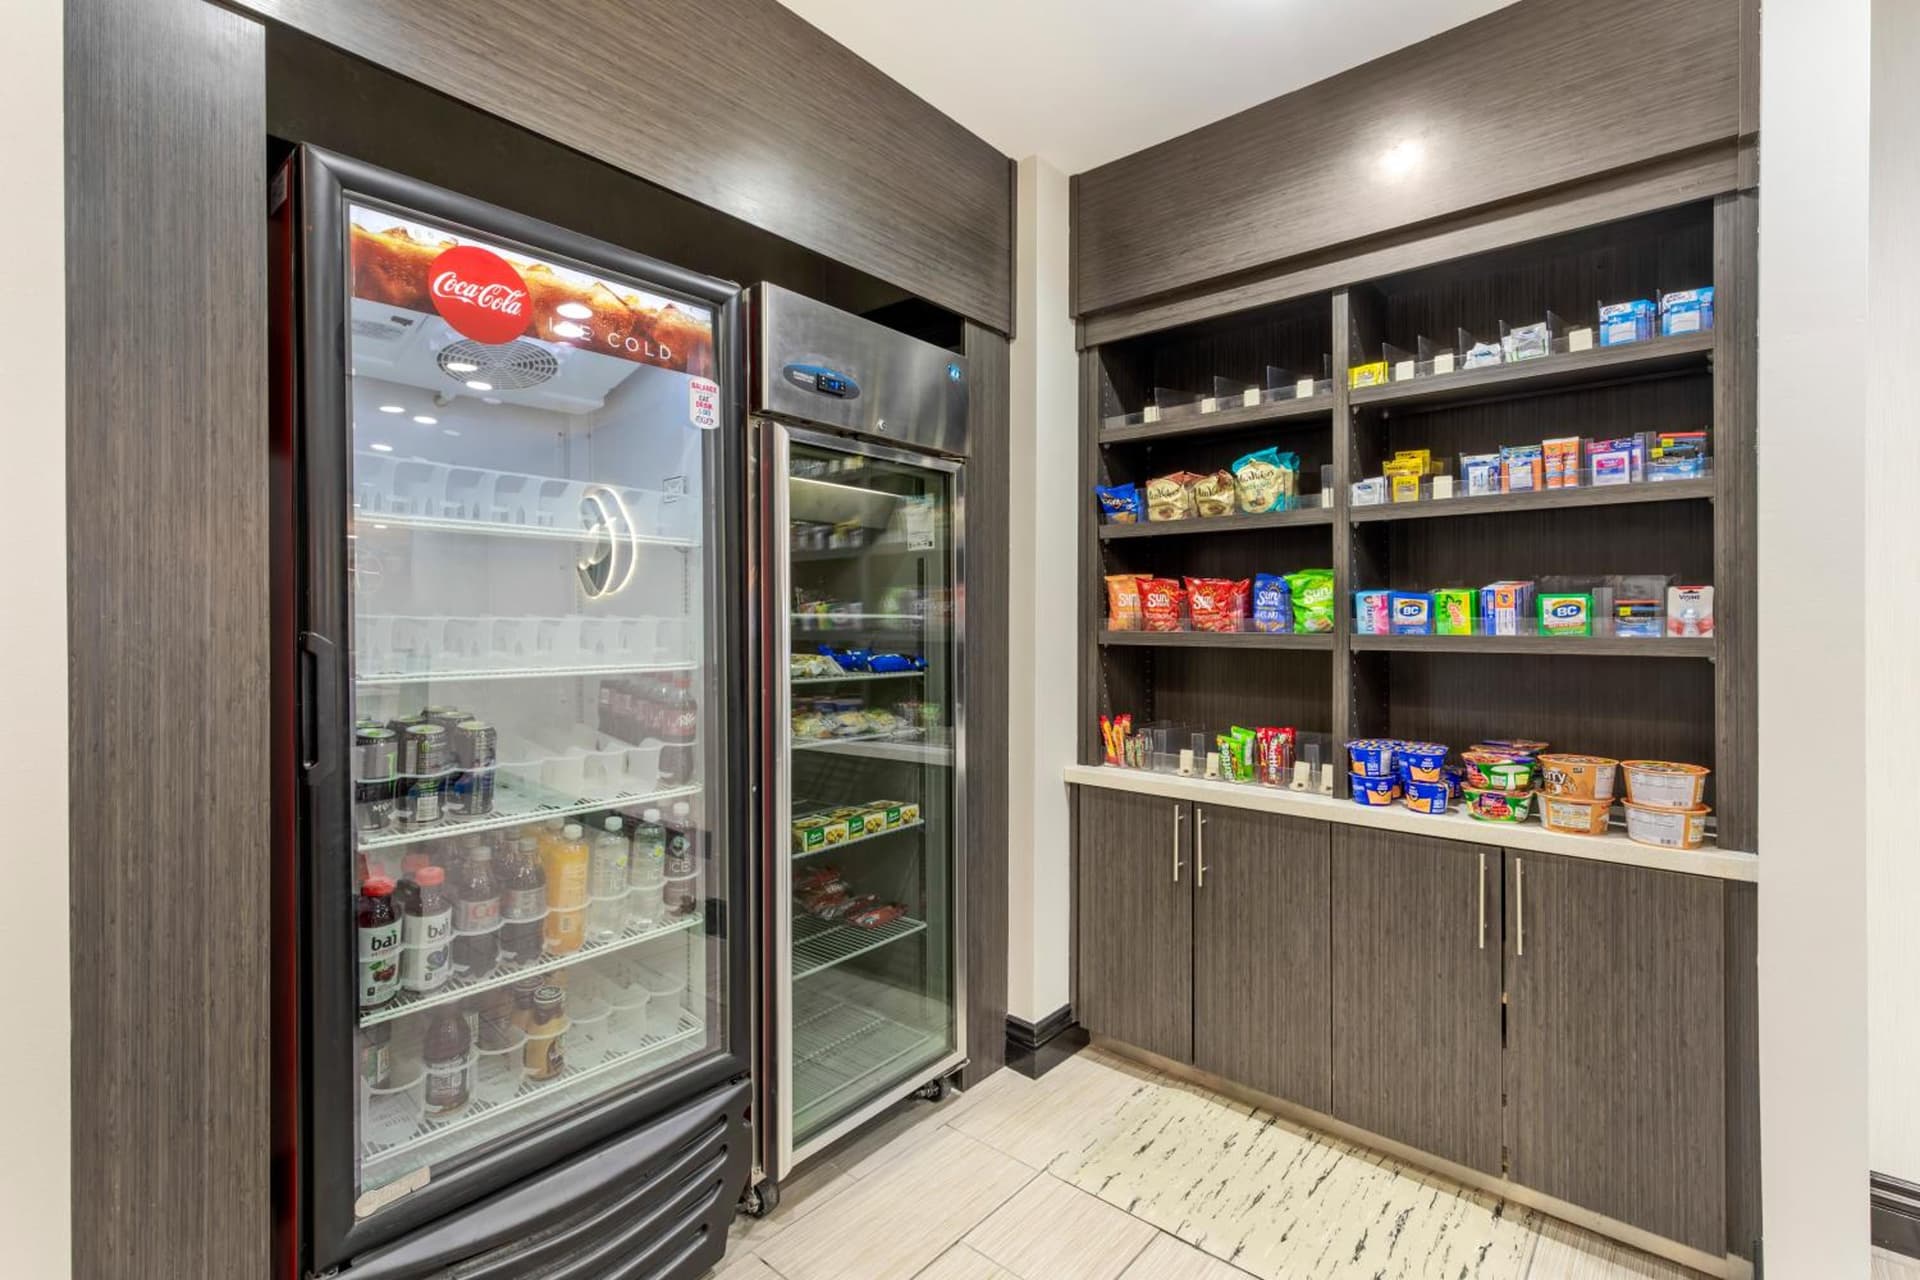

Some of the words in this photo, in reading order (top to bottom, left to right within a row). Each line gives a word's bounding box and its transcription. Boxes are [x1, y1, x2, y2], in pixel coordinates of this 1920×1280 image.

[432, 271, 527, 316] Coca-Cola
[607, 332, 672, 360] COLD
[1257, 590, 1279, 606] Sun
[1403, 606, 1419, 615] BC
[1557, 606, 1577, 616] BC
[371, 930, 397, 951] bai
